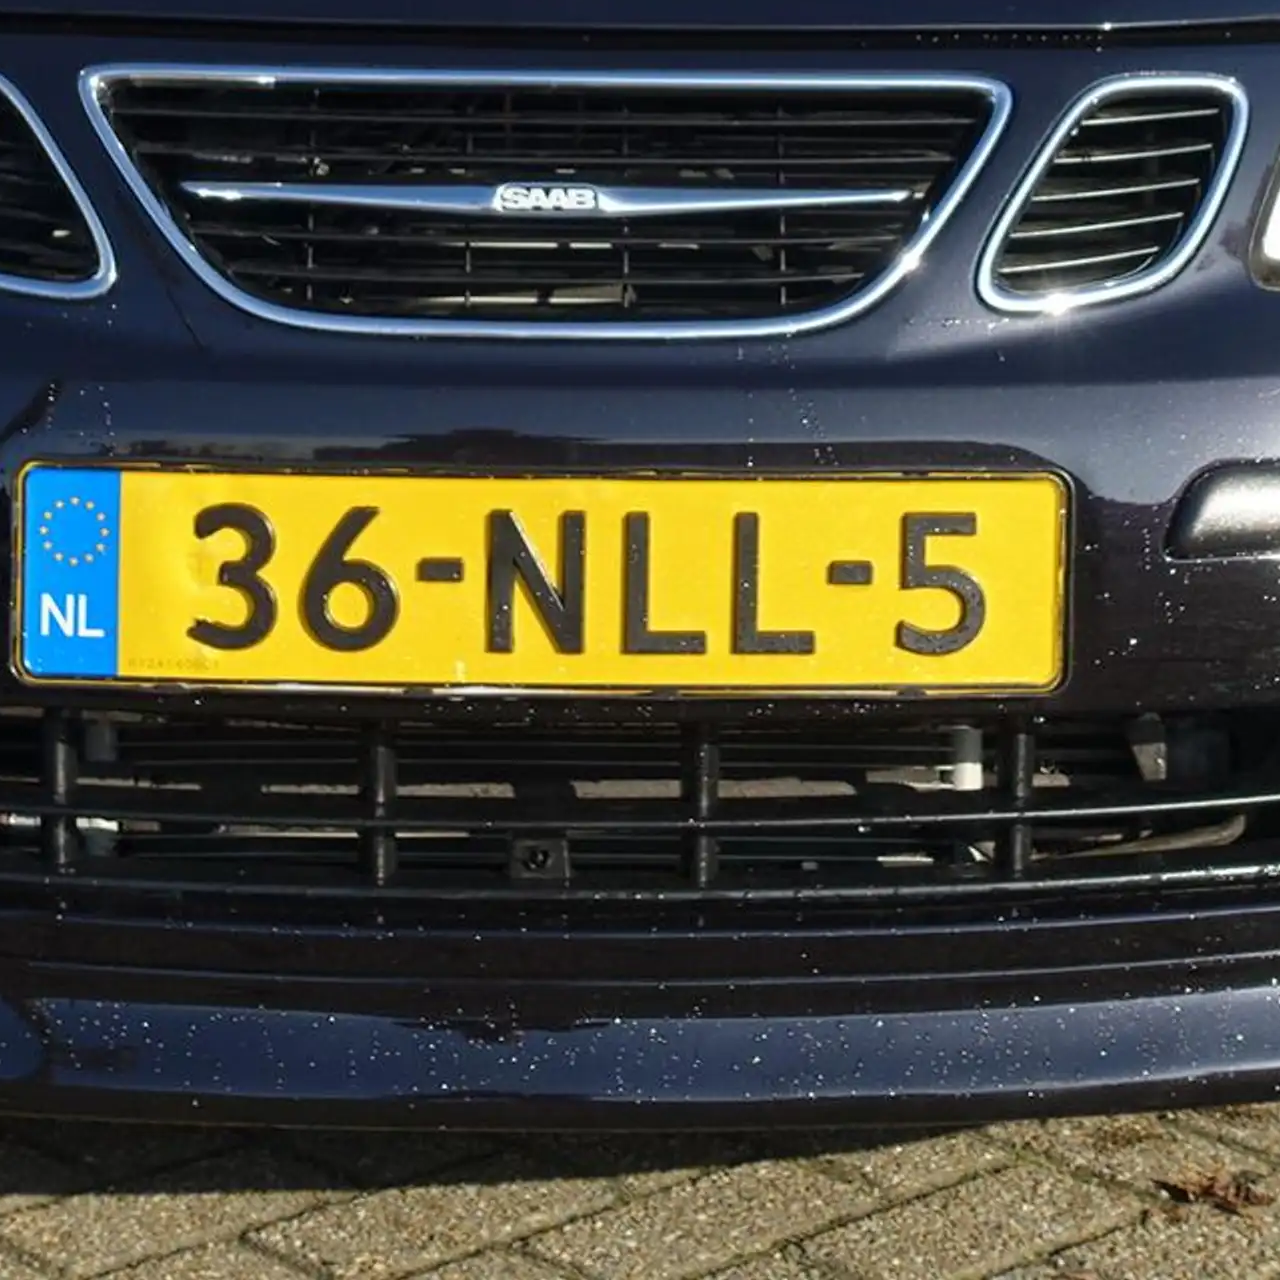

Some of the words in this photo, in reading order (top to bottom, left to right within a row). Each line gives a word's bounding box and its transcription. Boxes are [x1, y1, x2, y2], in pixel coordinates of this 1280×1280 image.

[502, 187, 596, 210] SAAB
[186, 501, 988, 655] 36-NLL-5
[40, 592, 105, 638] NL
